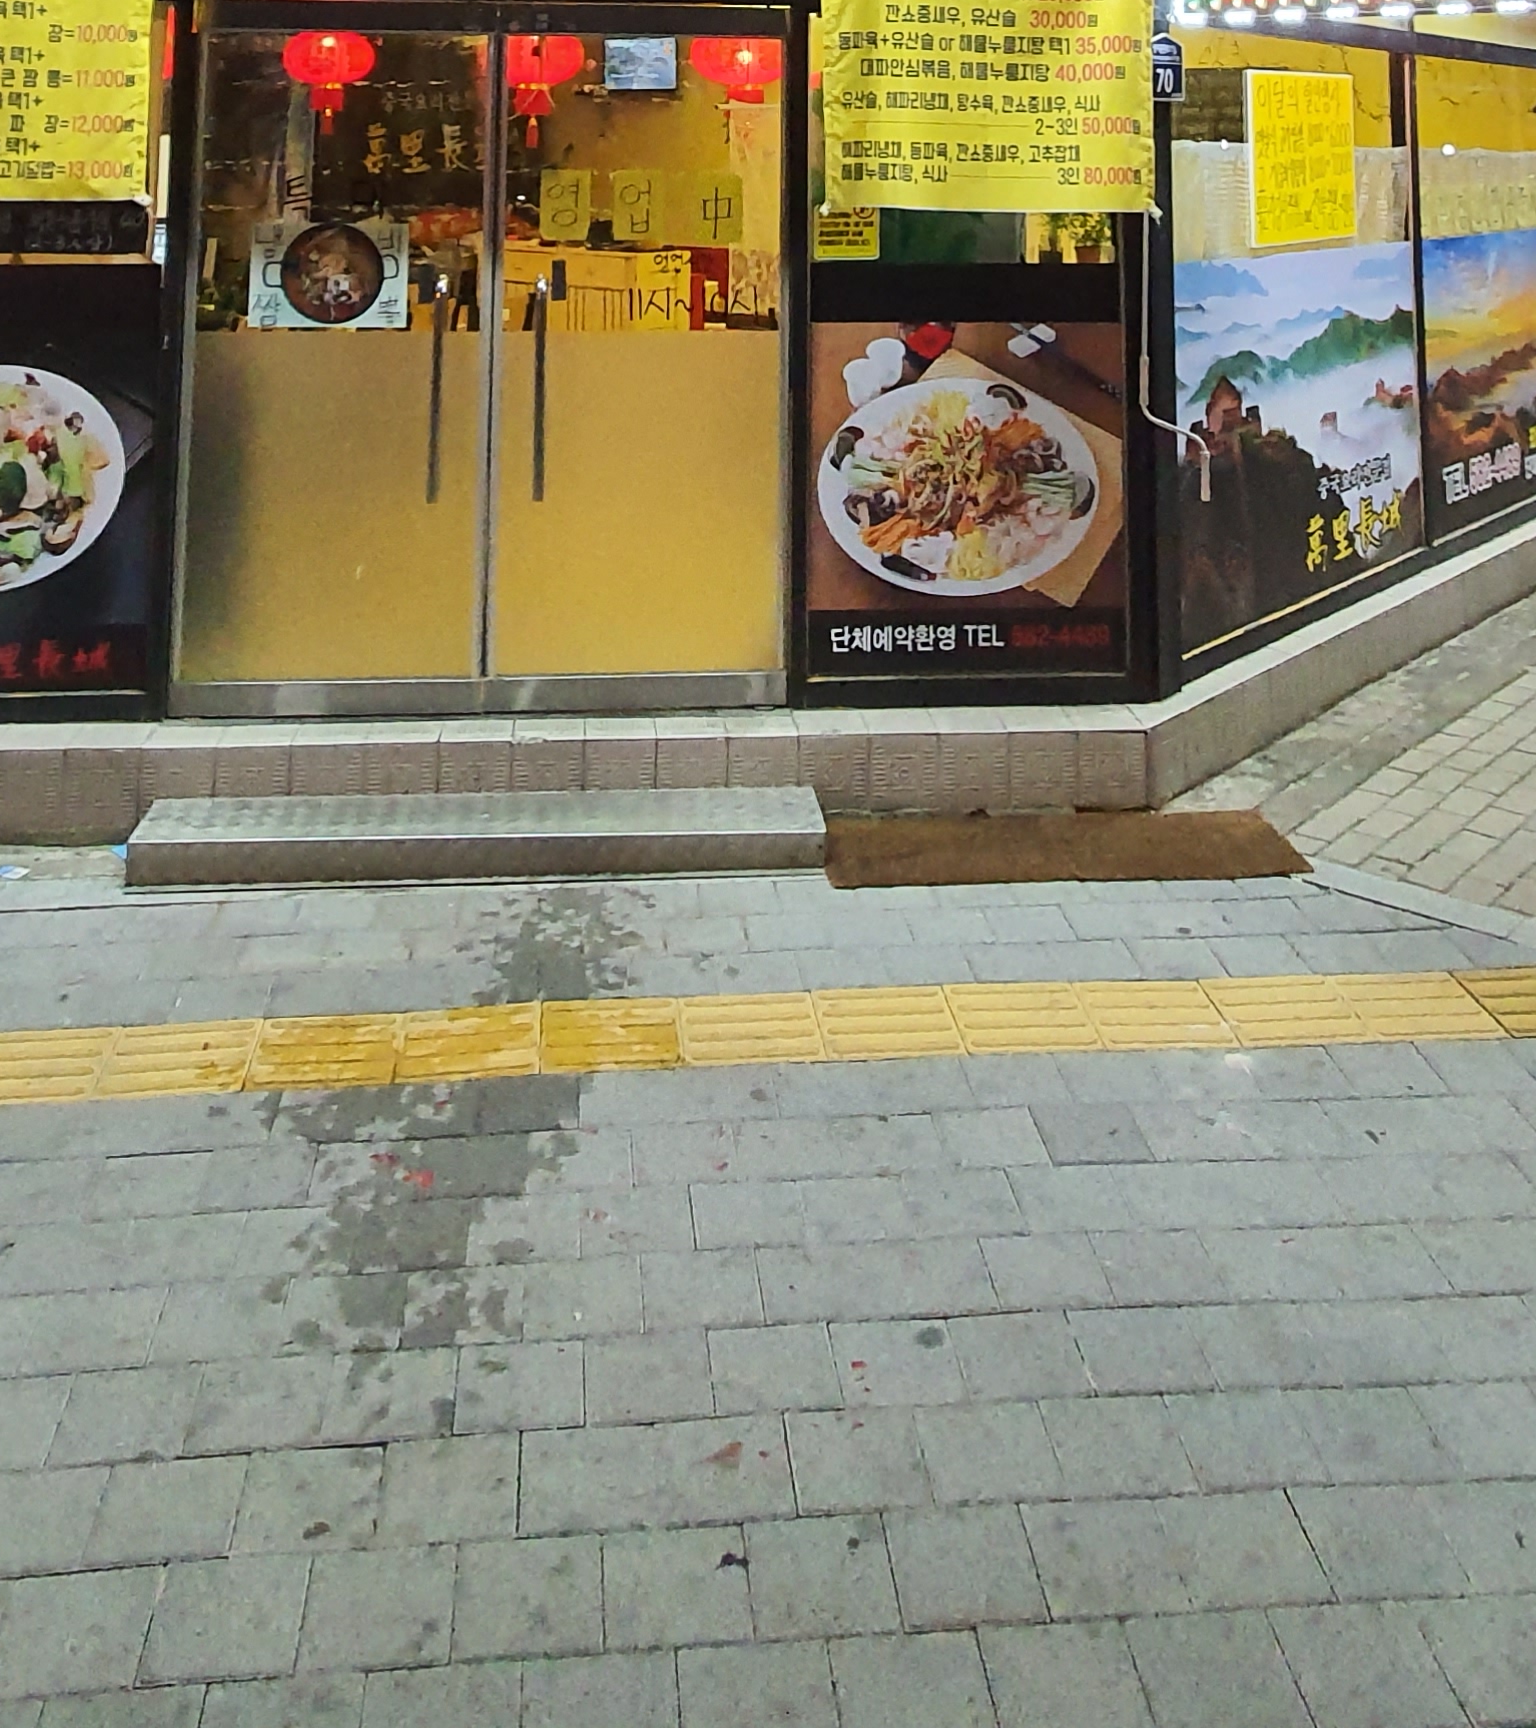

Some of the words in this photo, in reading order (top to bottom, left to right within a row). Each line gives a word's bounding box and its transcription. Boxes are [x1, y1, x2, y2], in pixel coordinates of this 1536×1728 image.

[971, 7, 1016, 27] 유산슬
[939, 37, 955, 52] or
[960, 61, 1051, 82] 해물누룽지탕
[1155, 68, 1175, 94] 70
[1074, 94, 1101, 112] 식사
[1028, 144, 1081, 164] 고추잡채
[922, 164, 949, 183] 식사
[1057, 166, 1080, 186] 3인
[830, 624, 957, 653] 단체예약환영
[963, 624, 1005, 648] TEL
